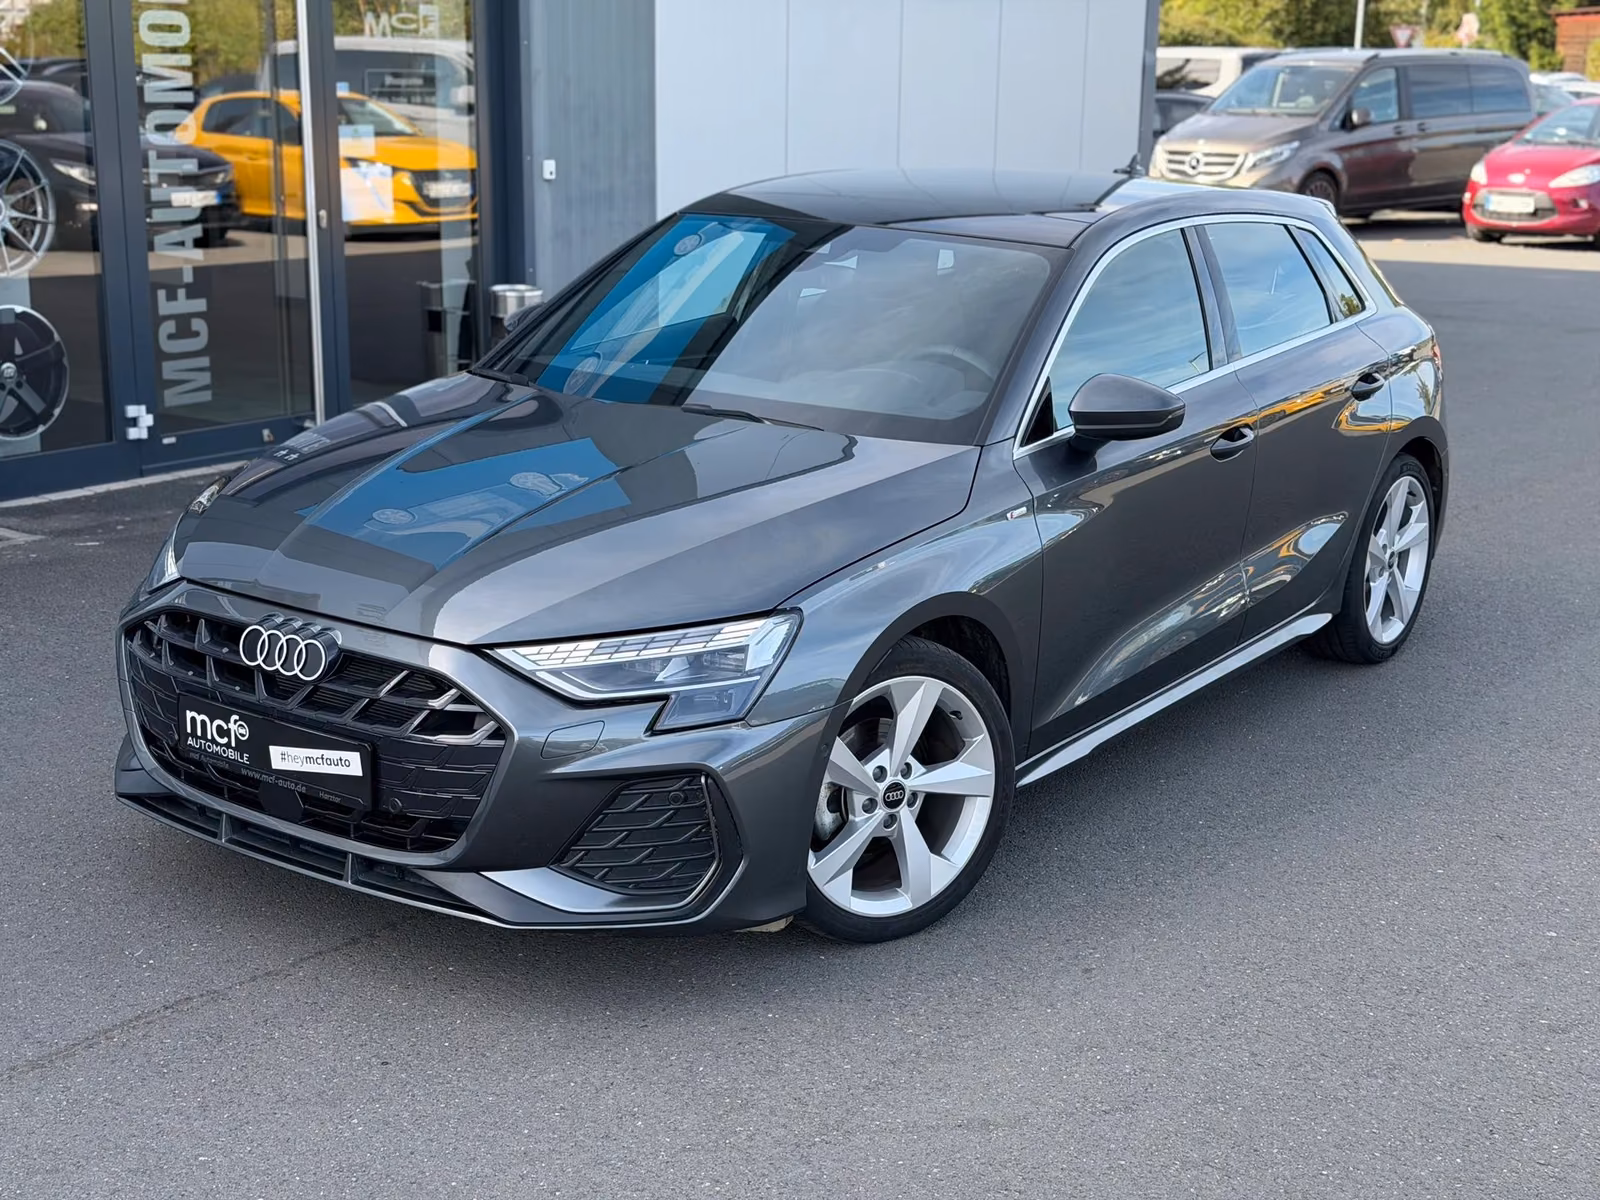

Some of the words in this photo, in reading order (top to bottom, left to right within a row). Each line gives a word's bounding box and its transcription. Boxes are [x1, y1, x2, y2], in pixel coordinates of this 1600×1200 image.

[364, 5, 438, 38] MCF
[138, 0, 213, 408] MCF-AUTOMO
[186, 709, 240, 747] mcf
[187, 736, 250, 764] AUTOMOBILE
[280, 751, 351, 768] #heymcfauto
[241, 768, 306, 793] www.mcf-auto.de
